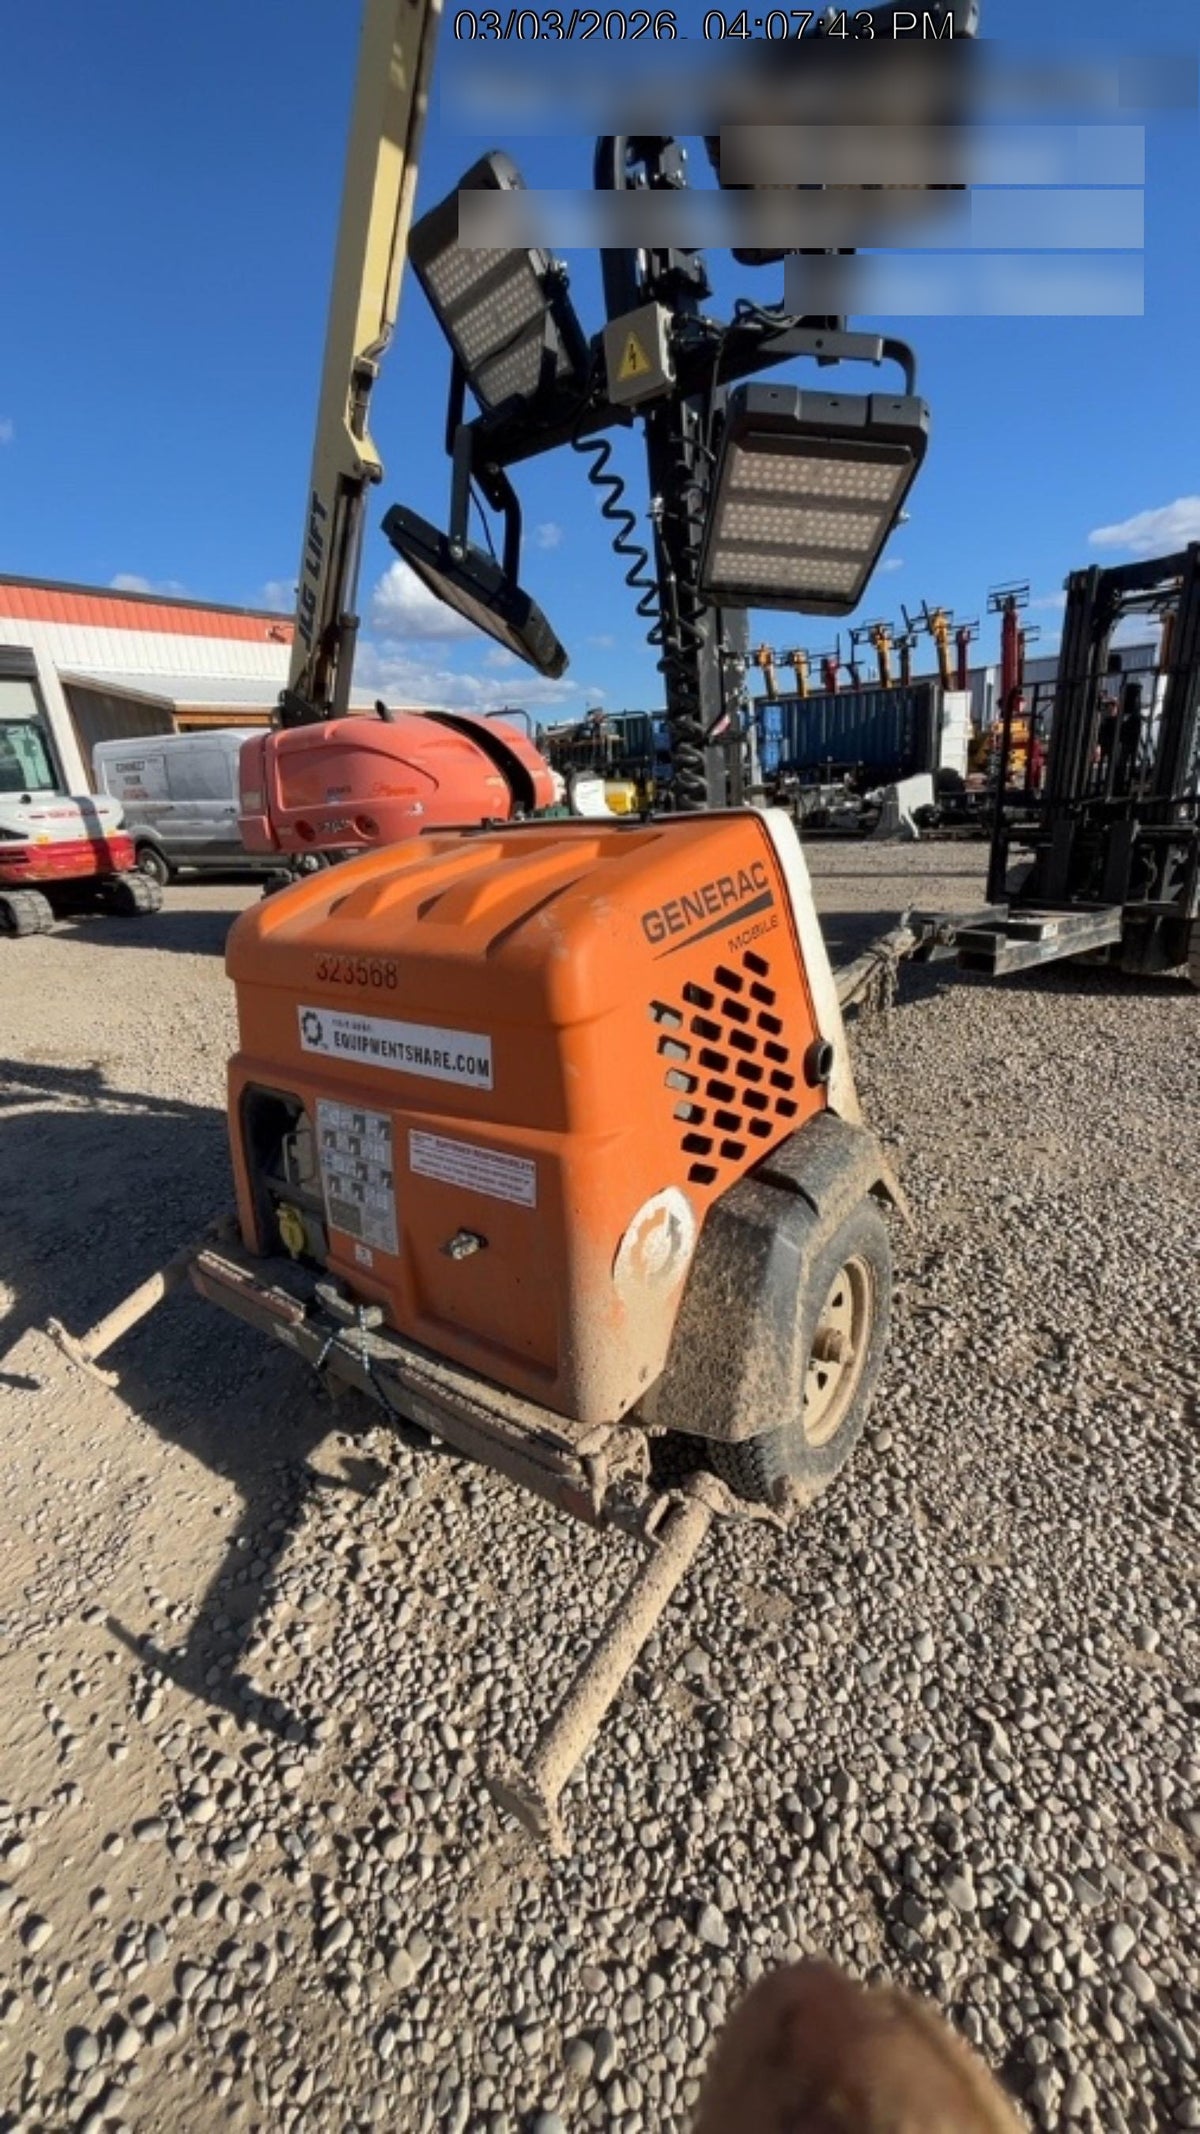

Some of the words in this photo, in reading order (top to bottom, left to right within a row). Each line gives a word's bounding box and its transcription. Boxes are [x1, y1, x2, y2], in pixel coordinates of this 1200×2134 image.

[305, 490, 327, 581] LIFT
[641, 861, 769, 944] GENERAC
[727, 915, 778, 953] MOBILE
[316, 956, 398, 990] 323568
[333, 1031, 490, 1077] EQUIPMENTSHARE.COM
